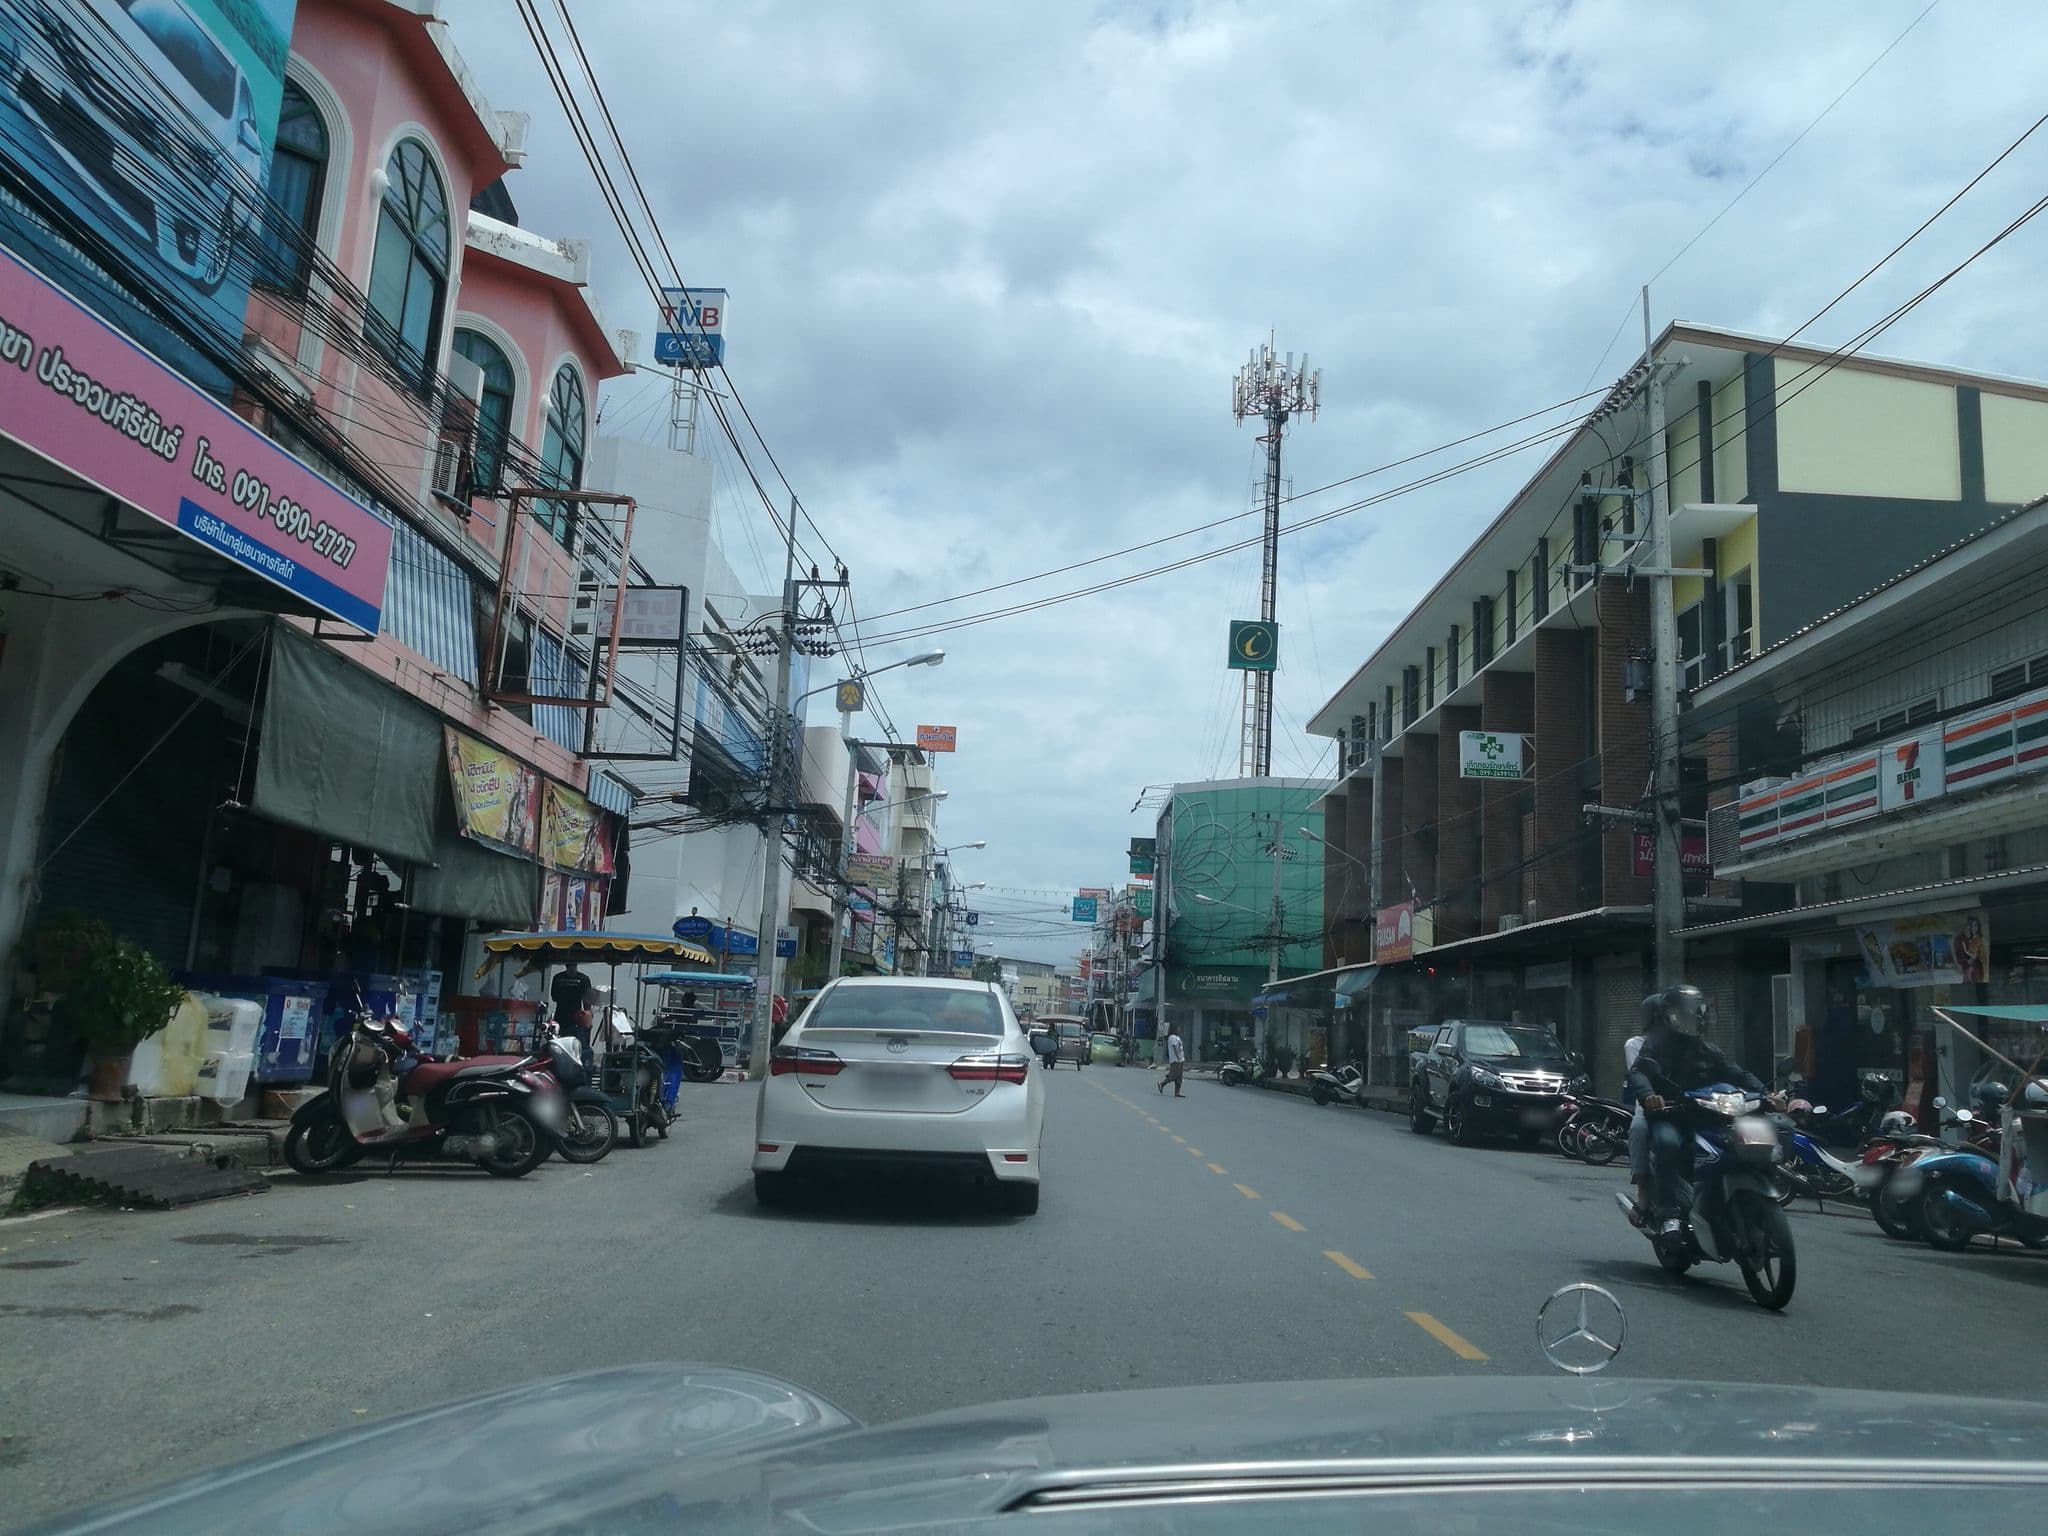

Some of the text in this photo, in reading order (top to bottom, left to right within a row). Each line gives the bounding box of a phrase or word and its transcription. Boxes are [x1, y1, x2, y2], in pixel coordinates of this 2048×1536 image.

[661, 299, 719, 327] TMB
[39, 349, 183, 460] ประจวบคีรีขันธ์
[193, 438, 227, 492] โทร.
[233, 471, 357, 568] 091-890-2727
[193, 514, 295, 580] บริษัทในกลุ่มธนาคารทิสโก้
